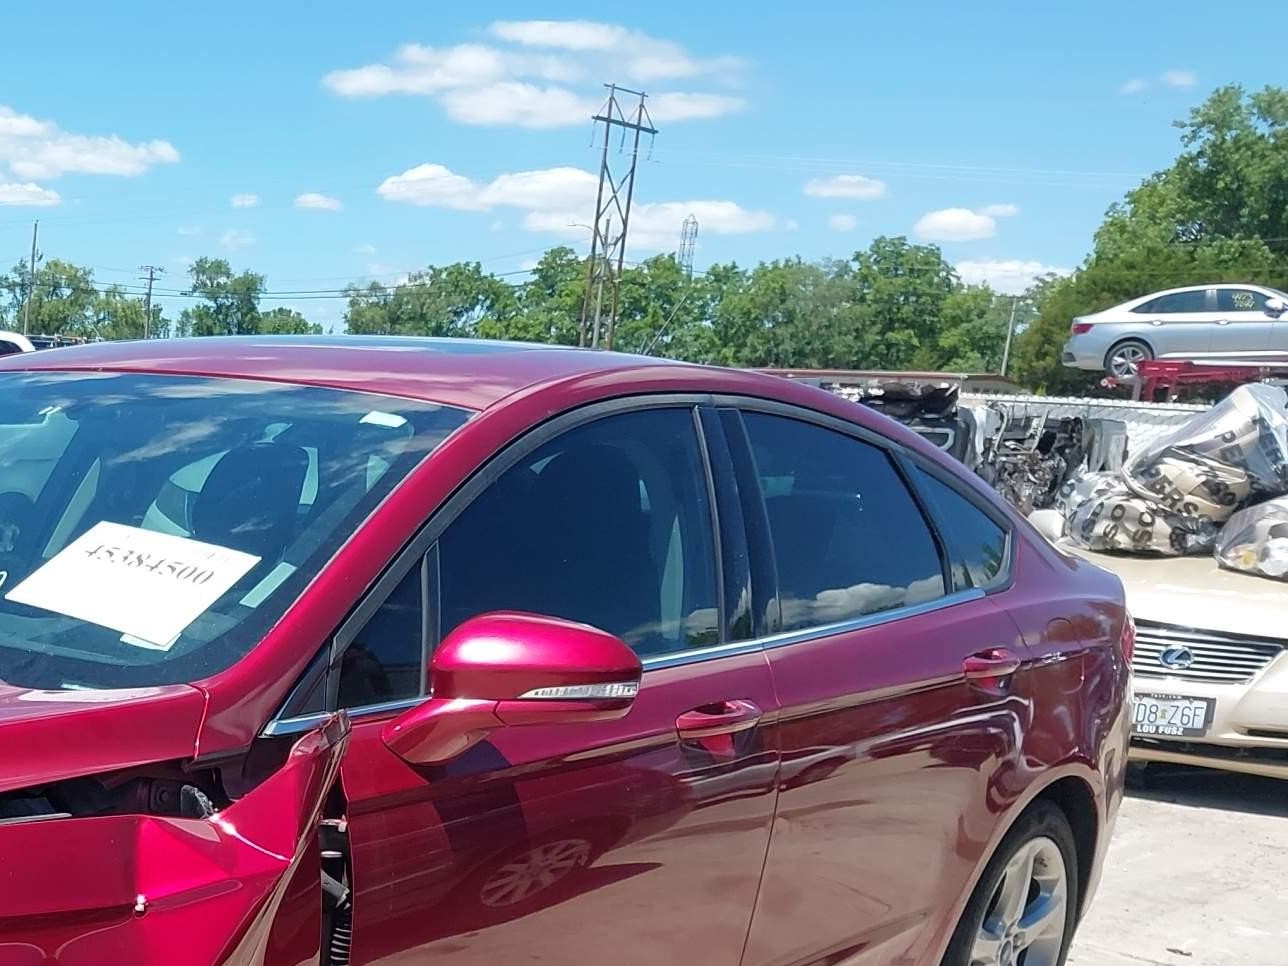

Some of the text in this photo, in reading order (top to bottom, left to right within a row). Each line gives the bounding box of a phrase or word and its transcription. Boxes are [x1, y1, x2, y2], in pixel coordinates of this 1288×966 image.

[85, 544, 215, 585] 45384500
[1131, 702, 1205, 728] D8 Z6F
[1136, 724, 1184, 736] LOU FUSZ
